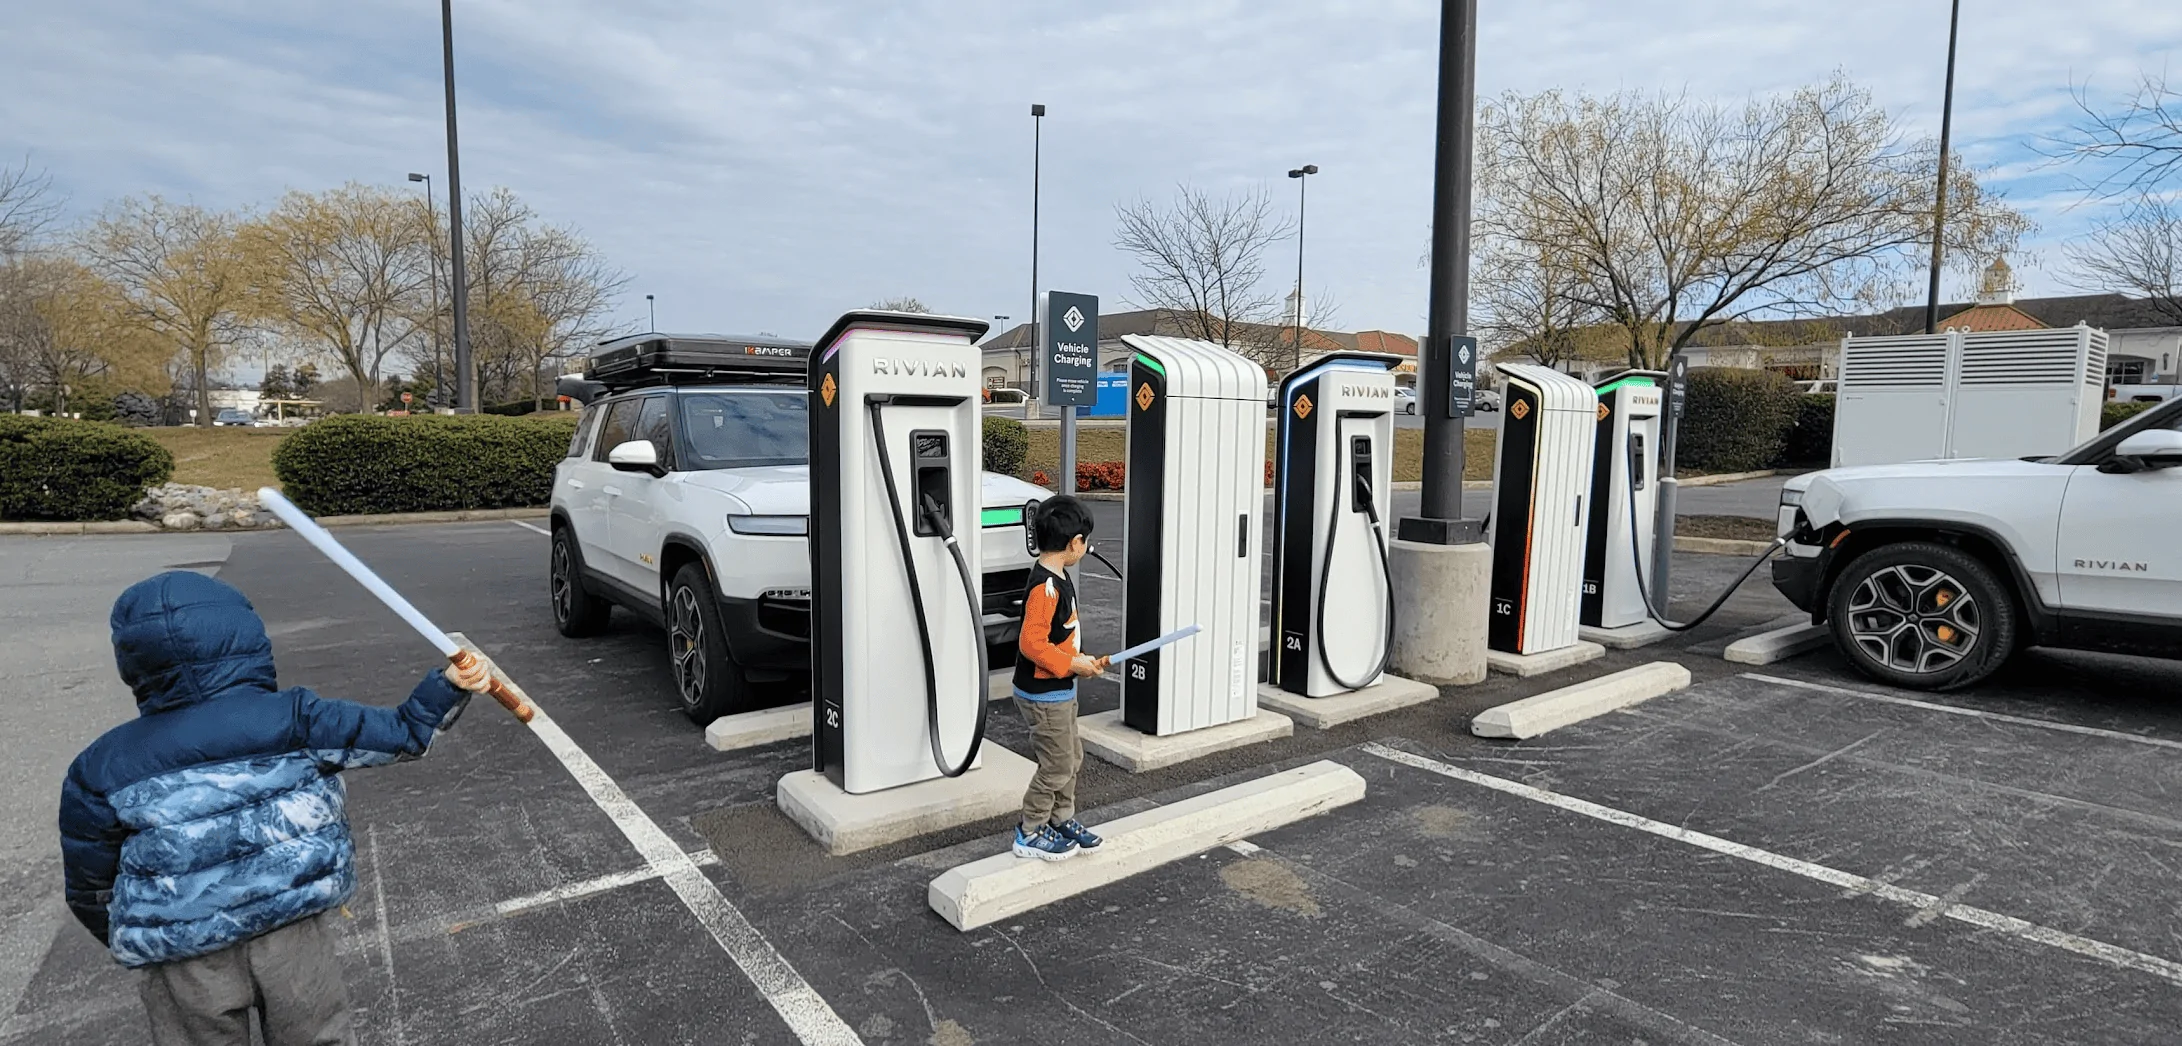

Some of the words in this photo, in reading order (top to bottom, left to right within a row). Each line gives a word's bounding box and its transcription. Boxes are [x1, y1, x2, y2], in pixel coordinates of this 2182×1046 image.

[1057, 342, 1089, 353] Vehicle
[1054, 354, 1092, 367] Charging
[872, 357, 967, 379] RIVIAN
[1341, 384, 1389, 399] RIVIAN
[1632, 395, 1659, 405] RIVIAN
[2074, 559, 2147, 572] RIVIAN
[1582, 583, 1597, 595] 1B
[1496, 602, 1511, 615] 1C
[1286, 636, 1301, 651] 2A
[1131, 663, 1146, 680] 2B
[826, 707, 839, 729] 2C
